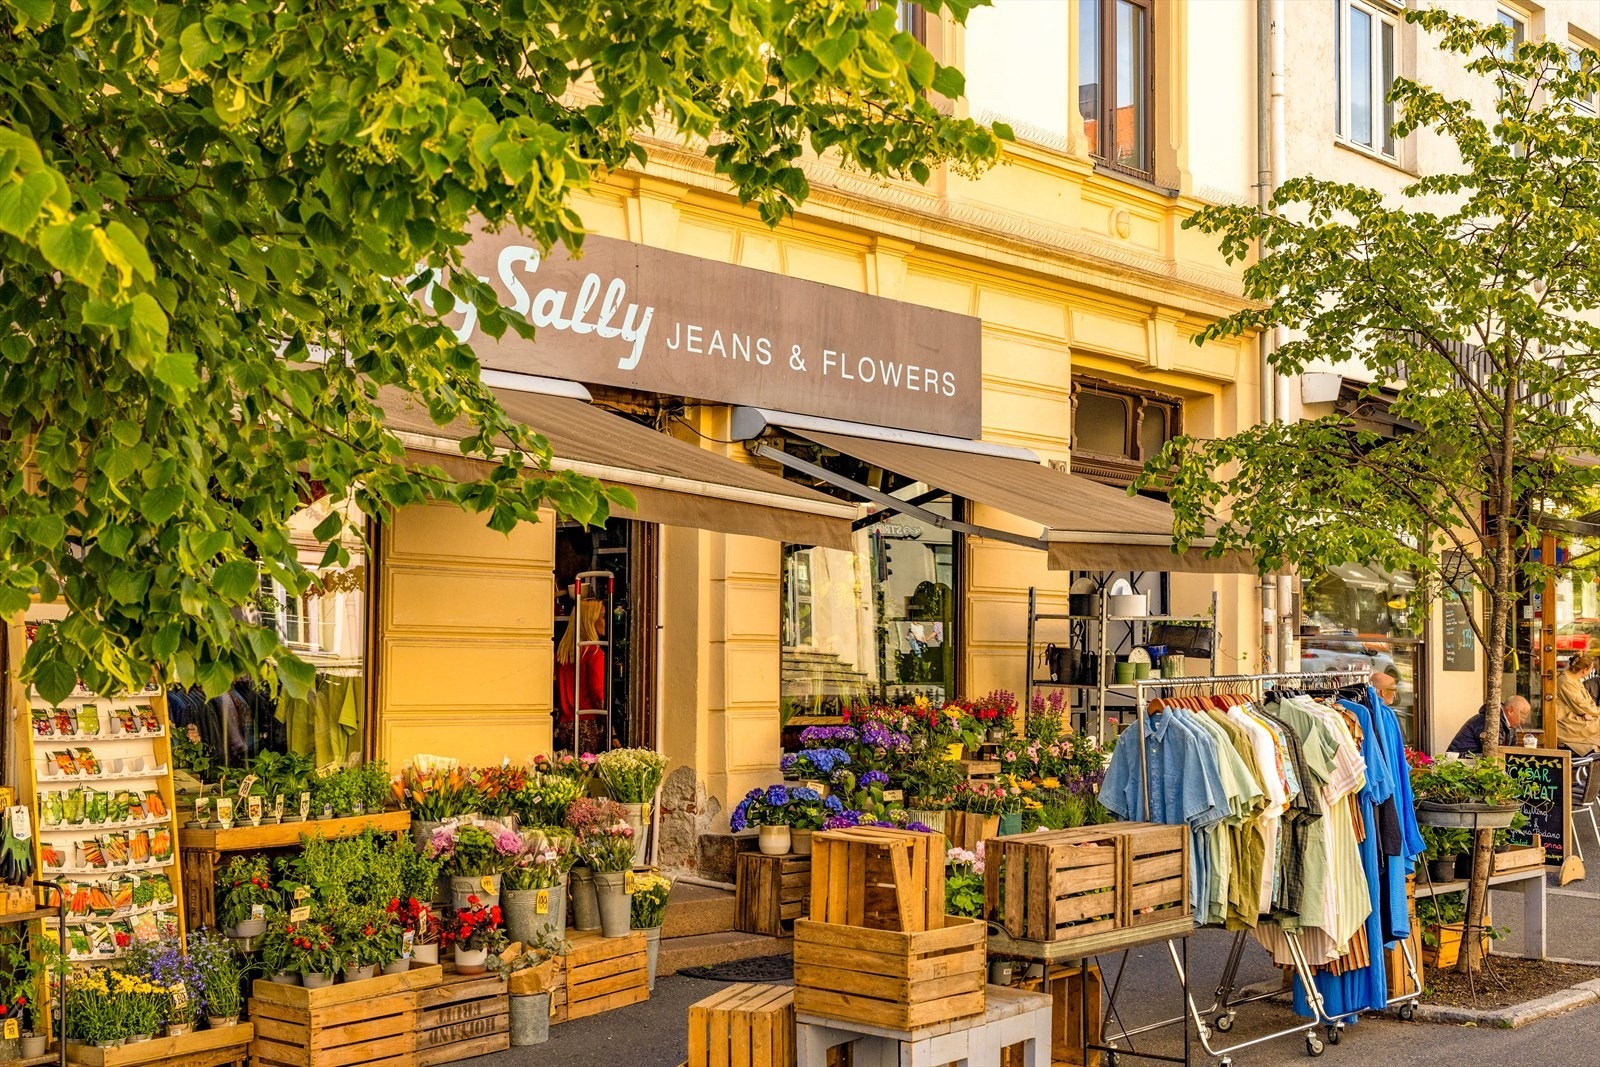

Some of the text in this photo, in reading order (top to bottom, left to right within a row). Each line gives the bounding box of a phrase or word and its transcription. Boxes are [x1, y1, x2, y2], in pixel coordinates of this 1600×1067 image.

[497, 245, 655, 371] Sally
[666, 322, 956, 397] JEANS & FLOWERS
[1512, 785, 1558, 801] ALAT
